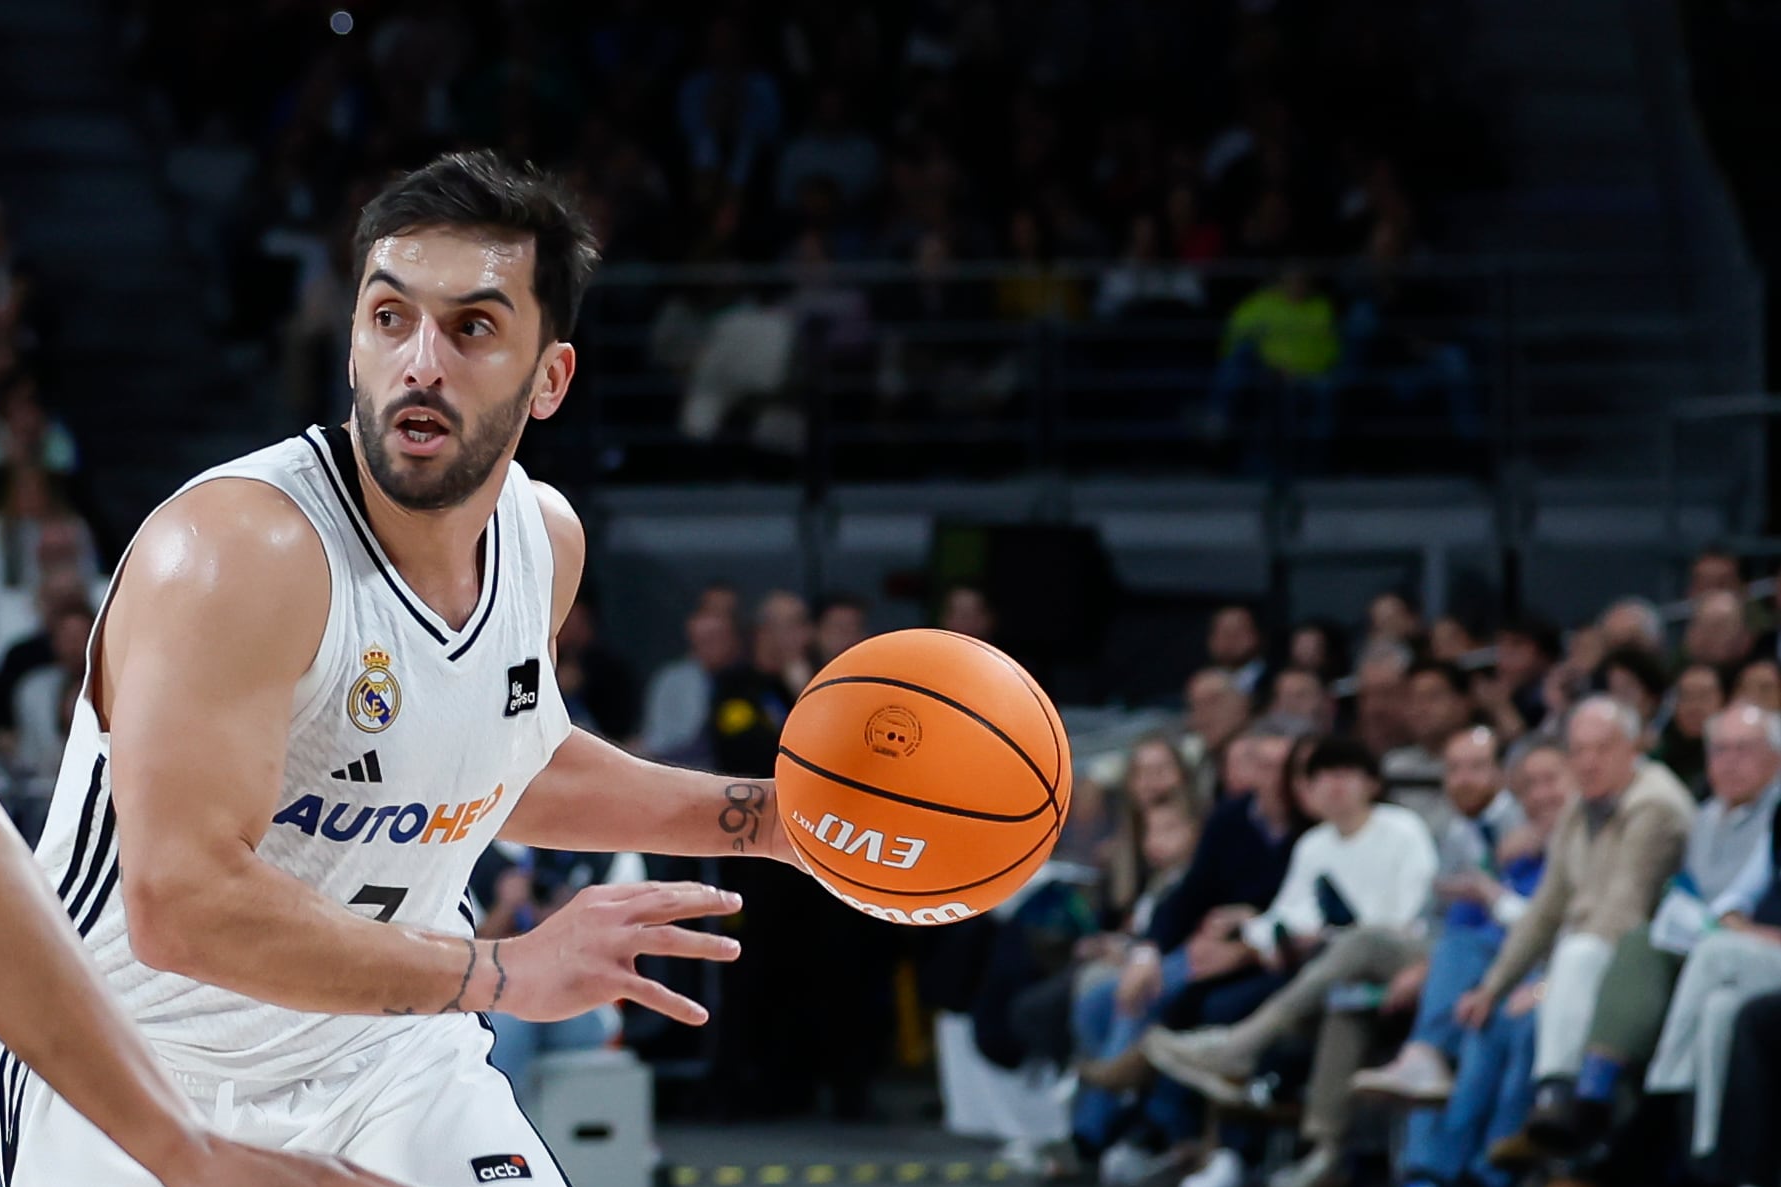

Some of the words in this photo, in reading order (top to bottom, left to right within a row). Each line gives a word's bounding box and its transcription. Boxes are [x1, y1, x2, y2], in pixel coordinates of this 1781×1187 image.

[814, 811, 927, 870] EVO
[346, 883, 409, 924] 7
[480, 1163, 520, 1180] acb
